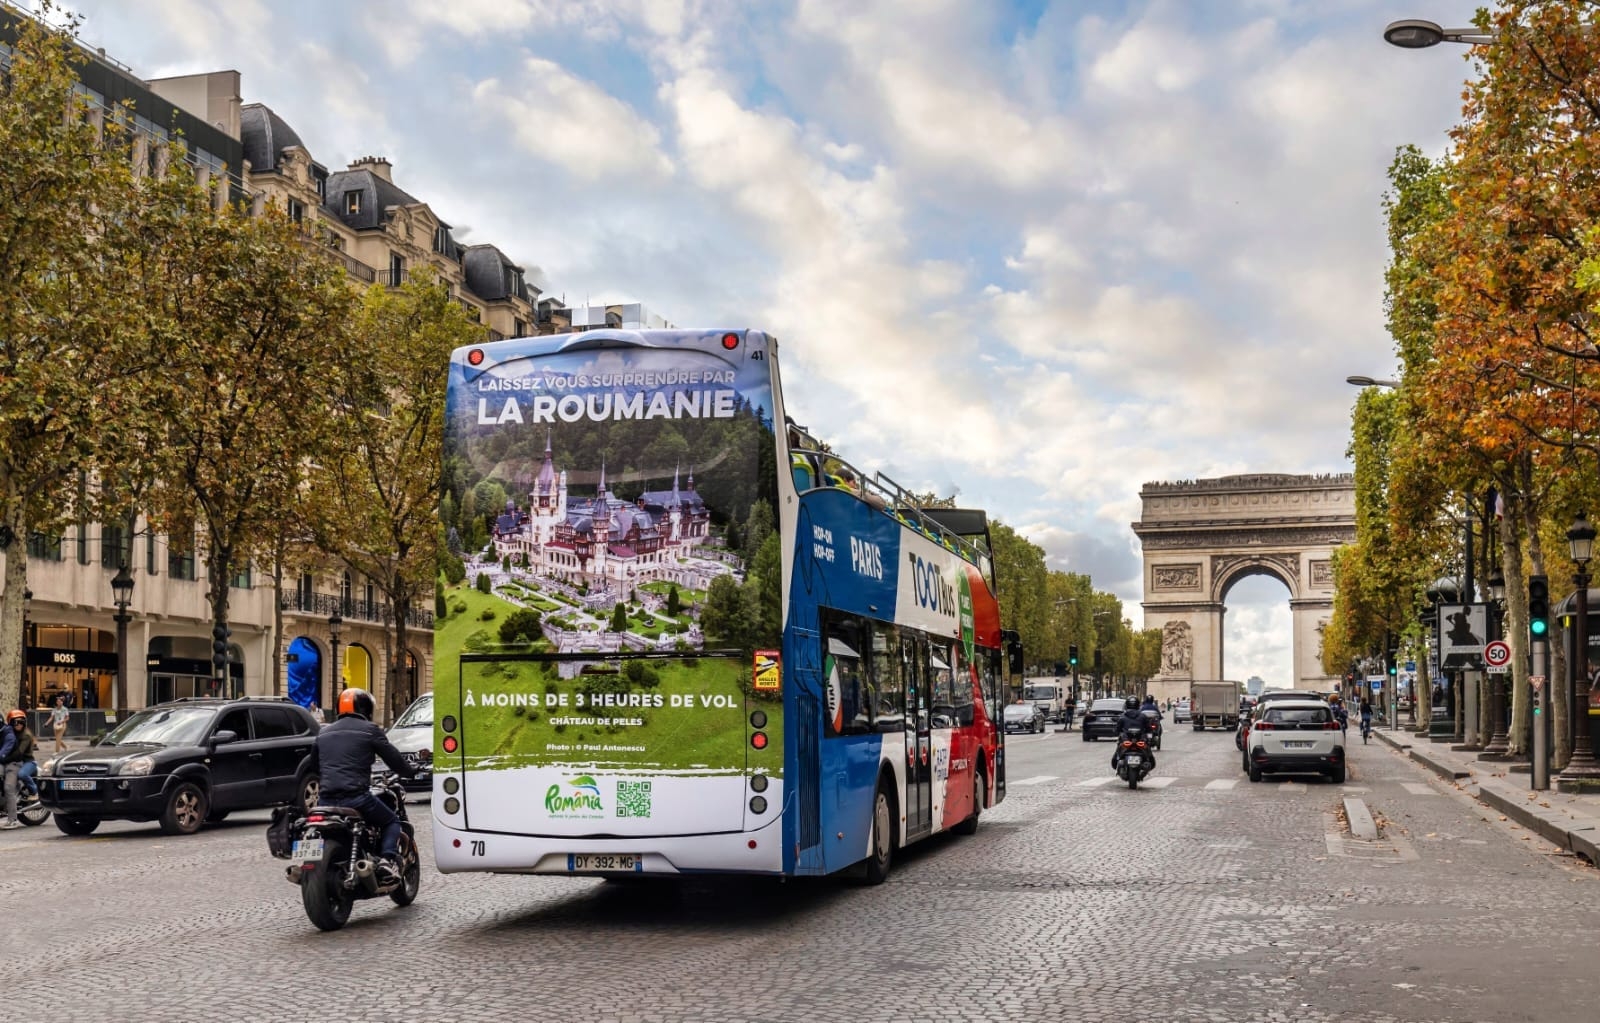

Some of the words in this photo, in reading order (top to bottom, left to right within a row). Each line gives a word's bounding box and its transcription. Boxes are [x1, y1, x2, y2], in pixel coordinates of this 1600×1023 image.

[751, 350, 763, 361] 41
[478, 378, 541, 392] LAISSEZ
[545, 376, 588, 389] VOUS
[592, 371, 699, 388] SURPRENDRE
[703, 370, 735, 384] PAR
[477, 397, 524, 425] LA
[533, 389, 735, 424] ROUMANIE
[850, 535, 883, 580] PARIS
[53, 653, 75, 663] BOSS
[1490, 649, 1505, 659] 50
[464, 688, 476, 706] À
[481, 693, 539, 707] MOINS
[546, 693, 569, 707] DE
[575, 693, 585, 707] 3
[591, 693, 664, 708] HEURES
[670, 694, 694, 708] DE
[700, 695, 738, 709] VOL
[549, 715, 594, 726] CHÂTEAU
[597, 718, 611, 726] DE
[613, 718, 643, 727] PELES
[546, 743, 570, 752] Photo
[583, 744, 602, 752] Paul
[602, 744, 646, 753] Antonescu
[470, 840, 486, 857] 70
[575, 855, 634, 869] DY-392-MG
